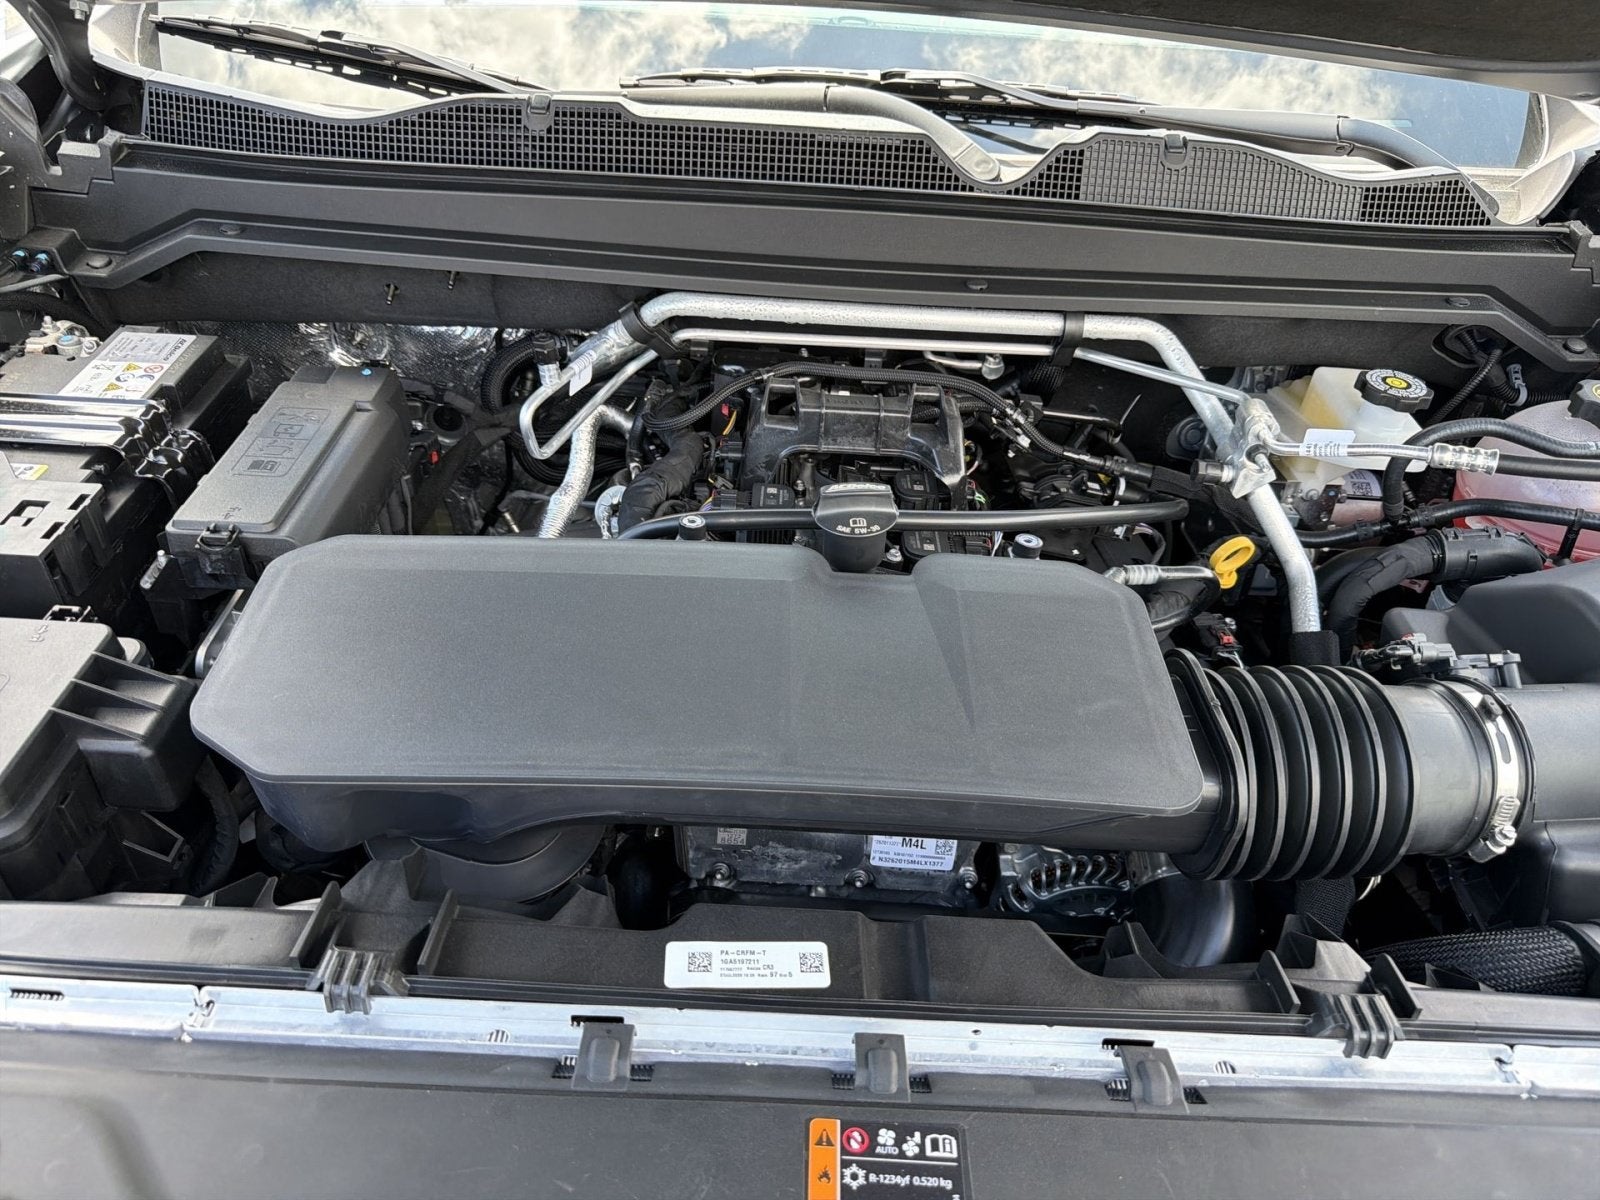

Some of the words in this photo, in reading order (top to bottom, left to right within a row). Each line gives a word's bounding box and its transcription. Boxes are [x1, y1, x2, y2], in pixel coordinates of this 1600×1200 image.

[836, 524, 852, 534] SAE
[854, 524, 881, 534] 5W-30
[901, 837, 928, 850] M4L
[878, 856, 945, 867] N3262015M4LX1377
[875, 1145, 899, 1156] AUTO
[868, 1173, 911, 1188] R-1234yf
[912, 1175, 939, 1187] 0.520
[939, 1176, 953, 1190] kg
